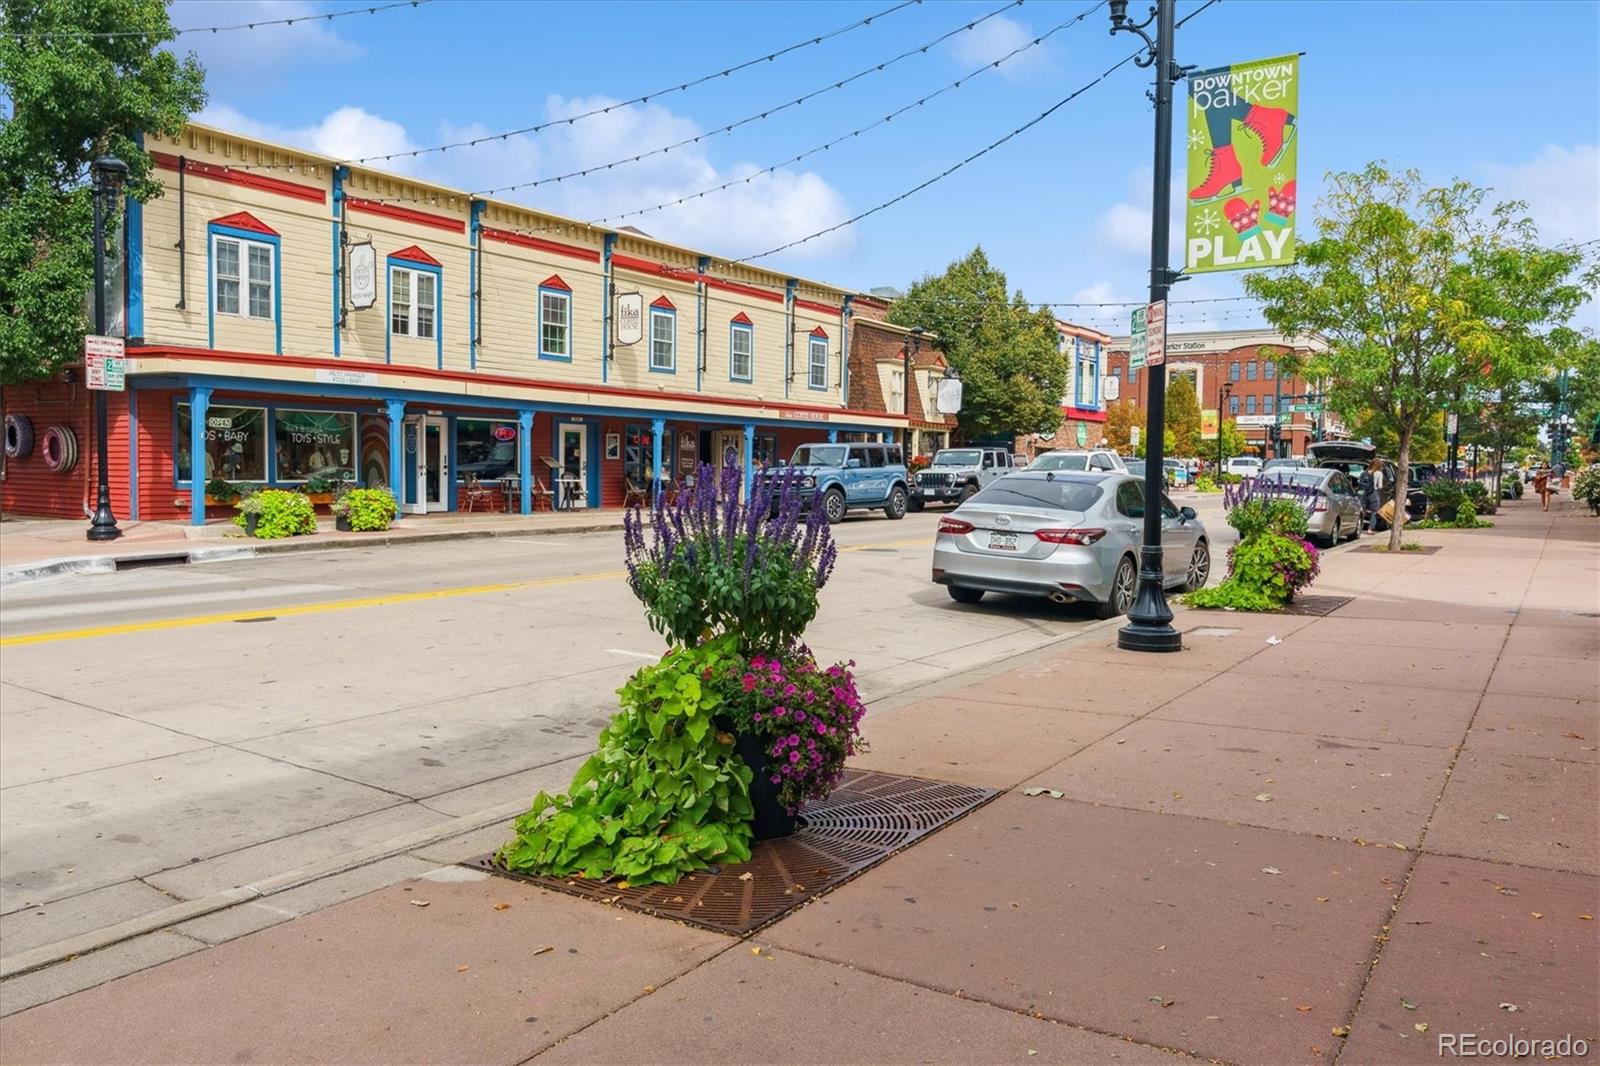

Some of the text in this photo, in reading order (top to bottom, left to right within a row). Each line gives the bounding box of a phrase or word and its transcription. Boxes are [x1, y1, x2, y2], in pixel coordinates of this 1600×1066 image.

[1193, 63, 1293, 92] DOWNTOWN
[1193, 77, 1293, 118] parker
[1188, 227, 1293, 268] PLAY
[1183, 341, 1206, 349] Station
[107, 359, 113, 371] 2
[209, 418, 231, 427] OPEN
[223, 431, 249, 442] BABY
[291, 432, 341, 444] TOYS STYLE
